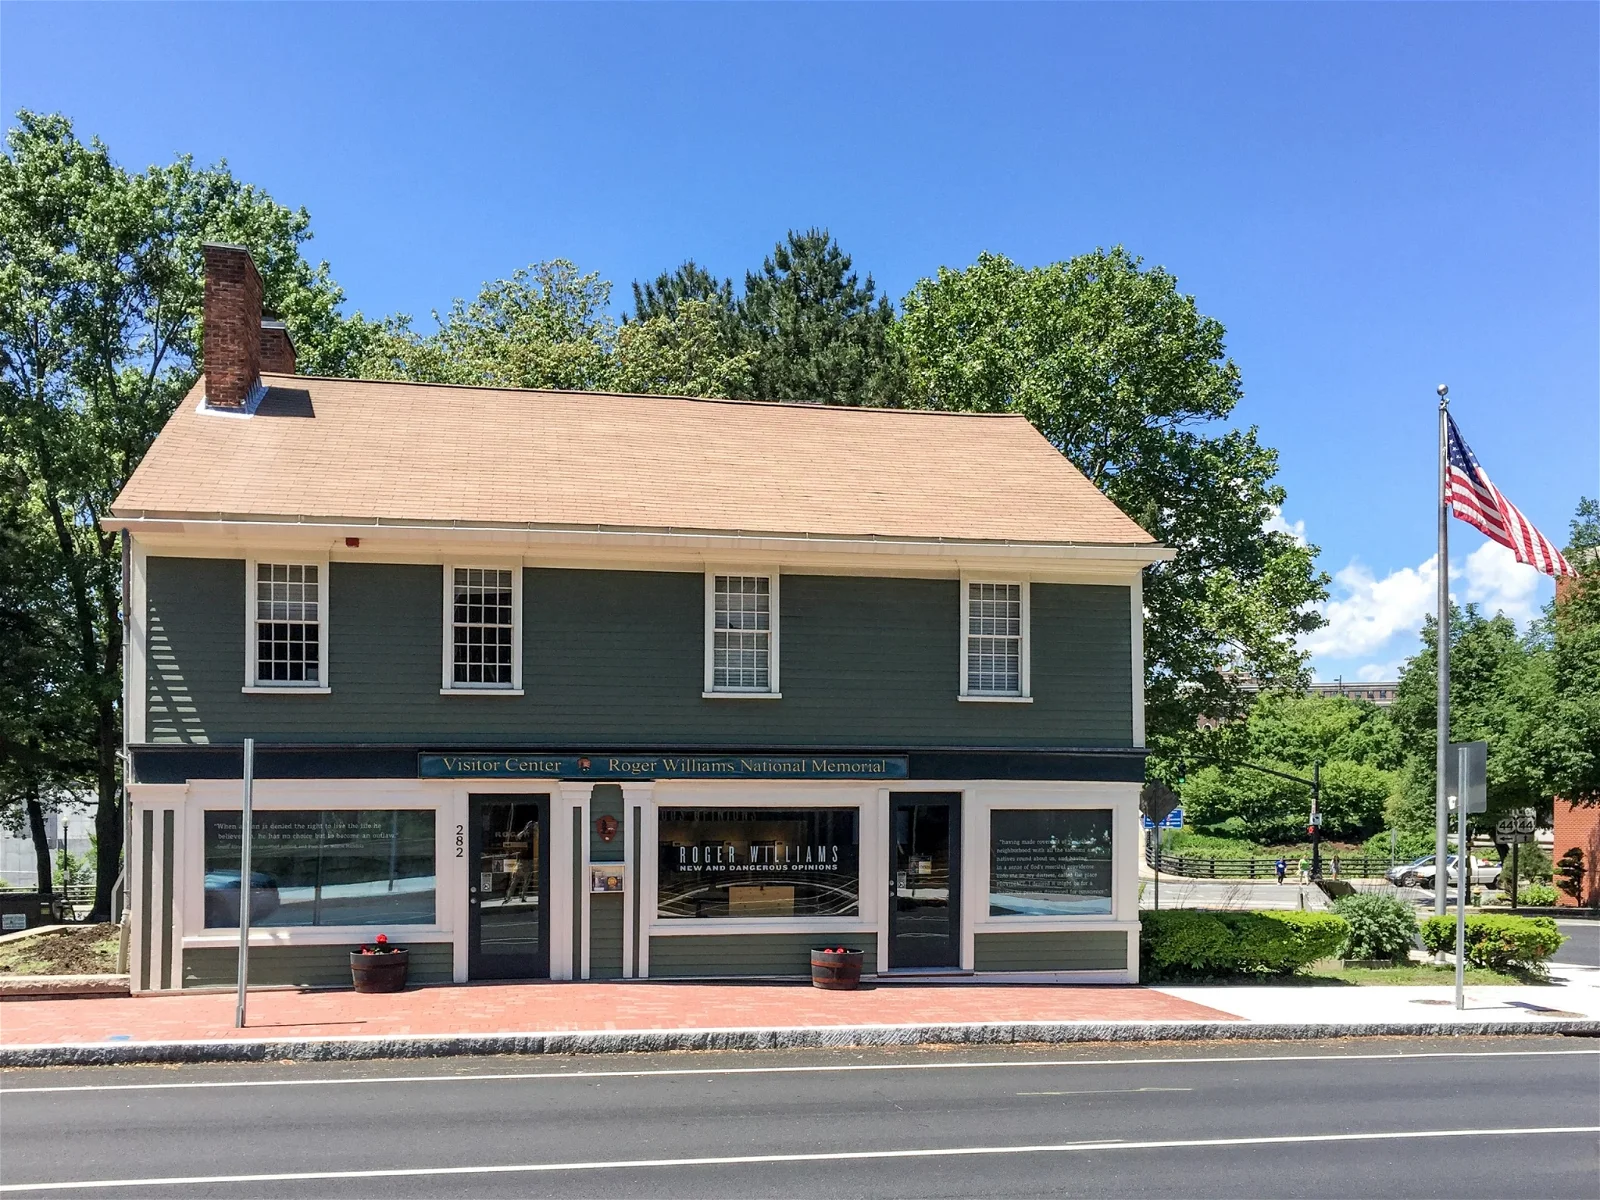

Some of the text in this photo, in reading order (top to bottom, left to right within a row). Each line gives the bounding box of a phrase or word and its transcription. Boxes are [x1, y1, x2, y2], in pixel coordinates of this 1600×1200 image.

[443, 757, 562, 771] Visitor Center
[608, 758, 887, 774] Roger Williams National Memorial
[308, 823, 323, 831] right
[1500, 821, 1514, 830] 44
[1519, 821, 1534, 830] 44
[456, 825, 464, 857] 282
[680, 845, 838, 864] ROGER WILLIAMS
